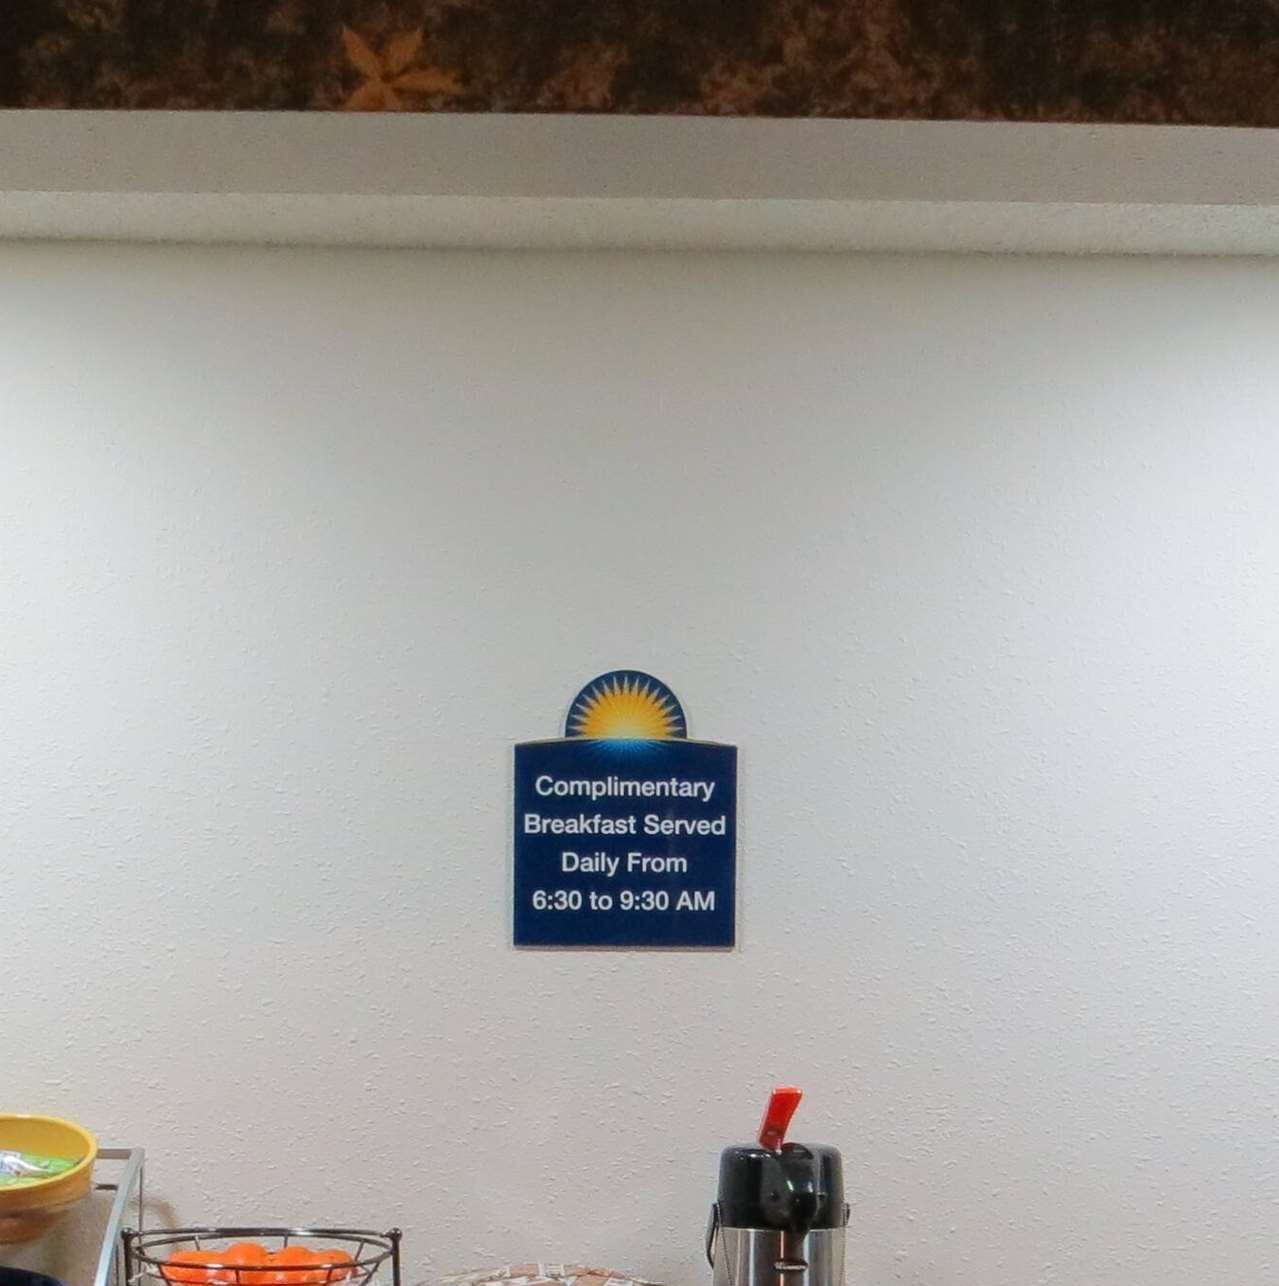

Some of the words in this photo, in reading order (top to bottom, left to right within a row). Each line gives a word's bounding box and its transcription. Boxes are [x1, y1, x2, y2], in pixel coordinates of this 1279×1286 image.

[535, 775, 715, 802] Complimentary
[524, 814, 637, 835] Breakfast
[643, 814, 726, 836] Served
[561, 852, 620, 877] Daily
[627, 852, 688, 873] From
[532, 890, 583, 911] 6:30
[589, 891, 613, 911] to
[619, 890, 670, 911] 9:30
[676, 891, 716, 911] AM
